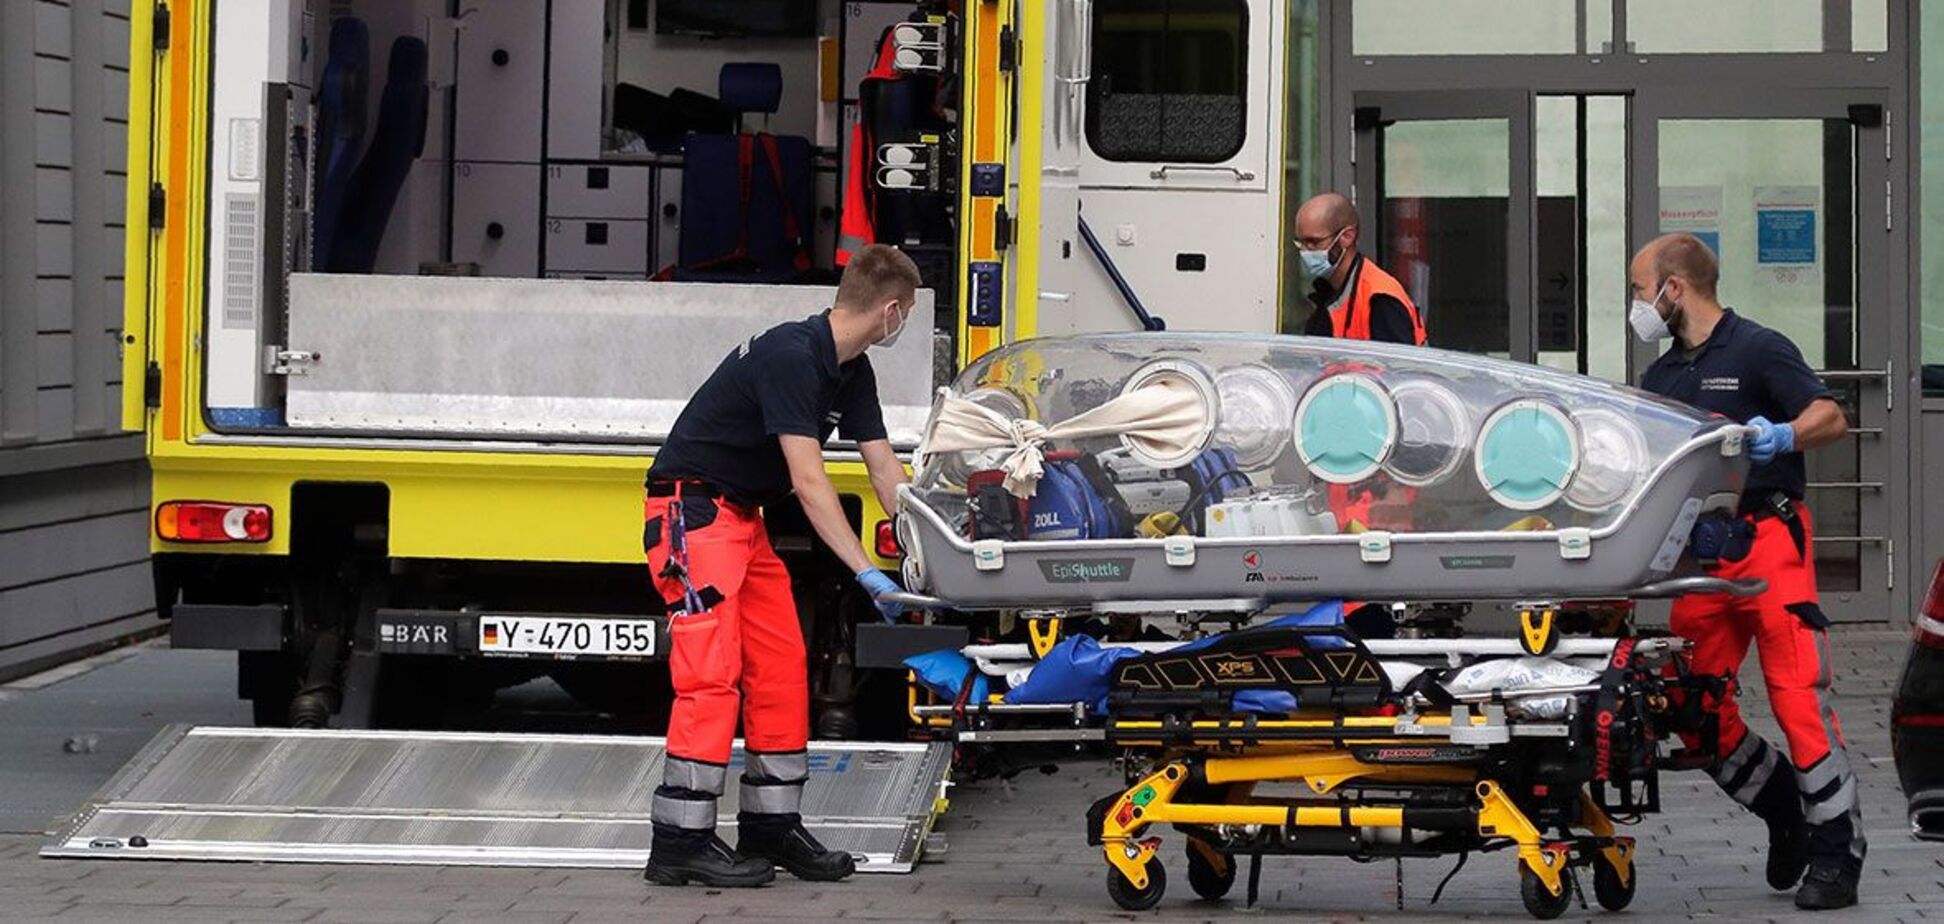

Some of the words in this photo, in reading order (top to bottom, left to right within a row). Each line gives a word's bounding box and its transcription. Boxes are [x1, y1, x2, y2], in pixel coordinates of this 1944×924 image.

[847, 4, 862, 17] 16
[456, 164, 472, 177] 10
[549, 166, 562, 179] 11
[548, 220, 562, 234] 12
[1033, 512, 1062, 528] ZOLL
[1051, 562, 1121, 579] EpiShuttle
[396, 624, 449, 643] BÄR
[602, 623, 649, 651] 155
[1216, 661, 1255, 675] XPS
